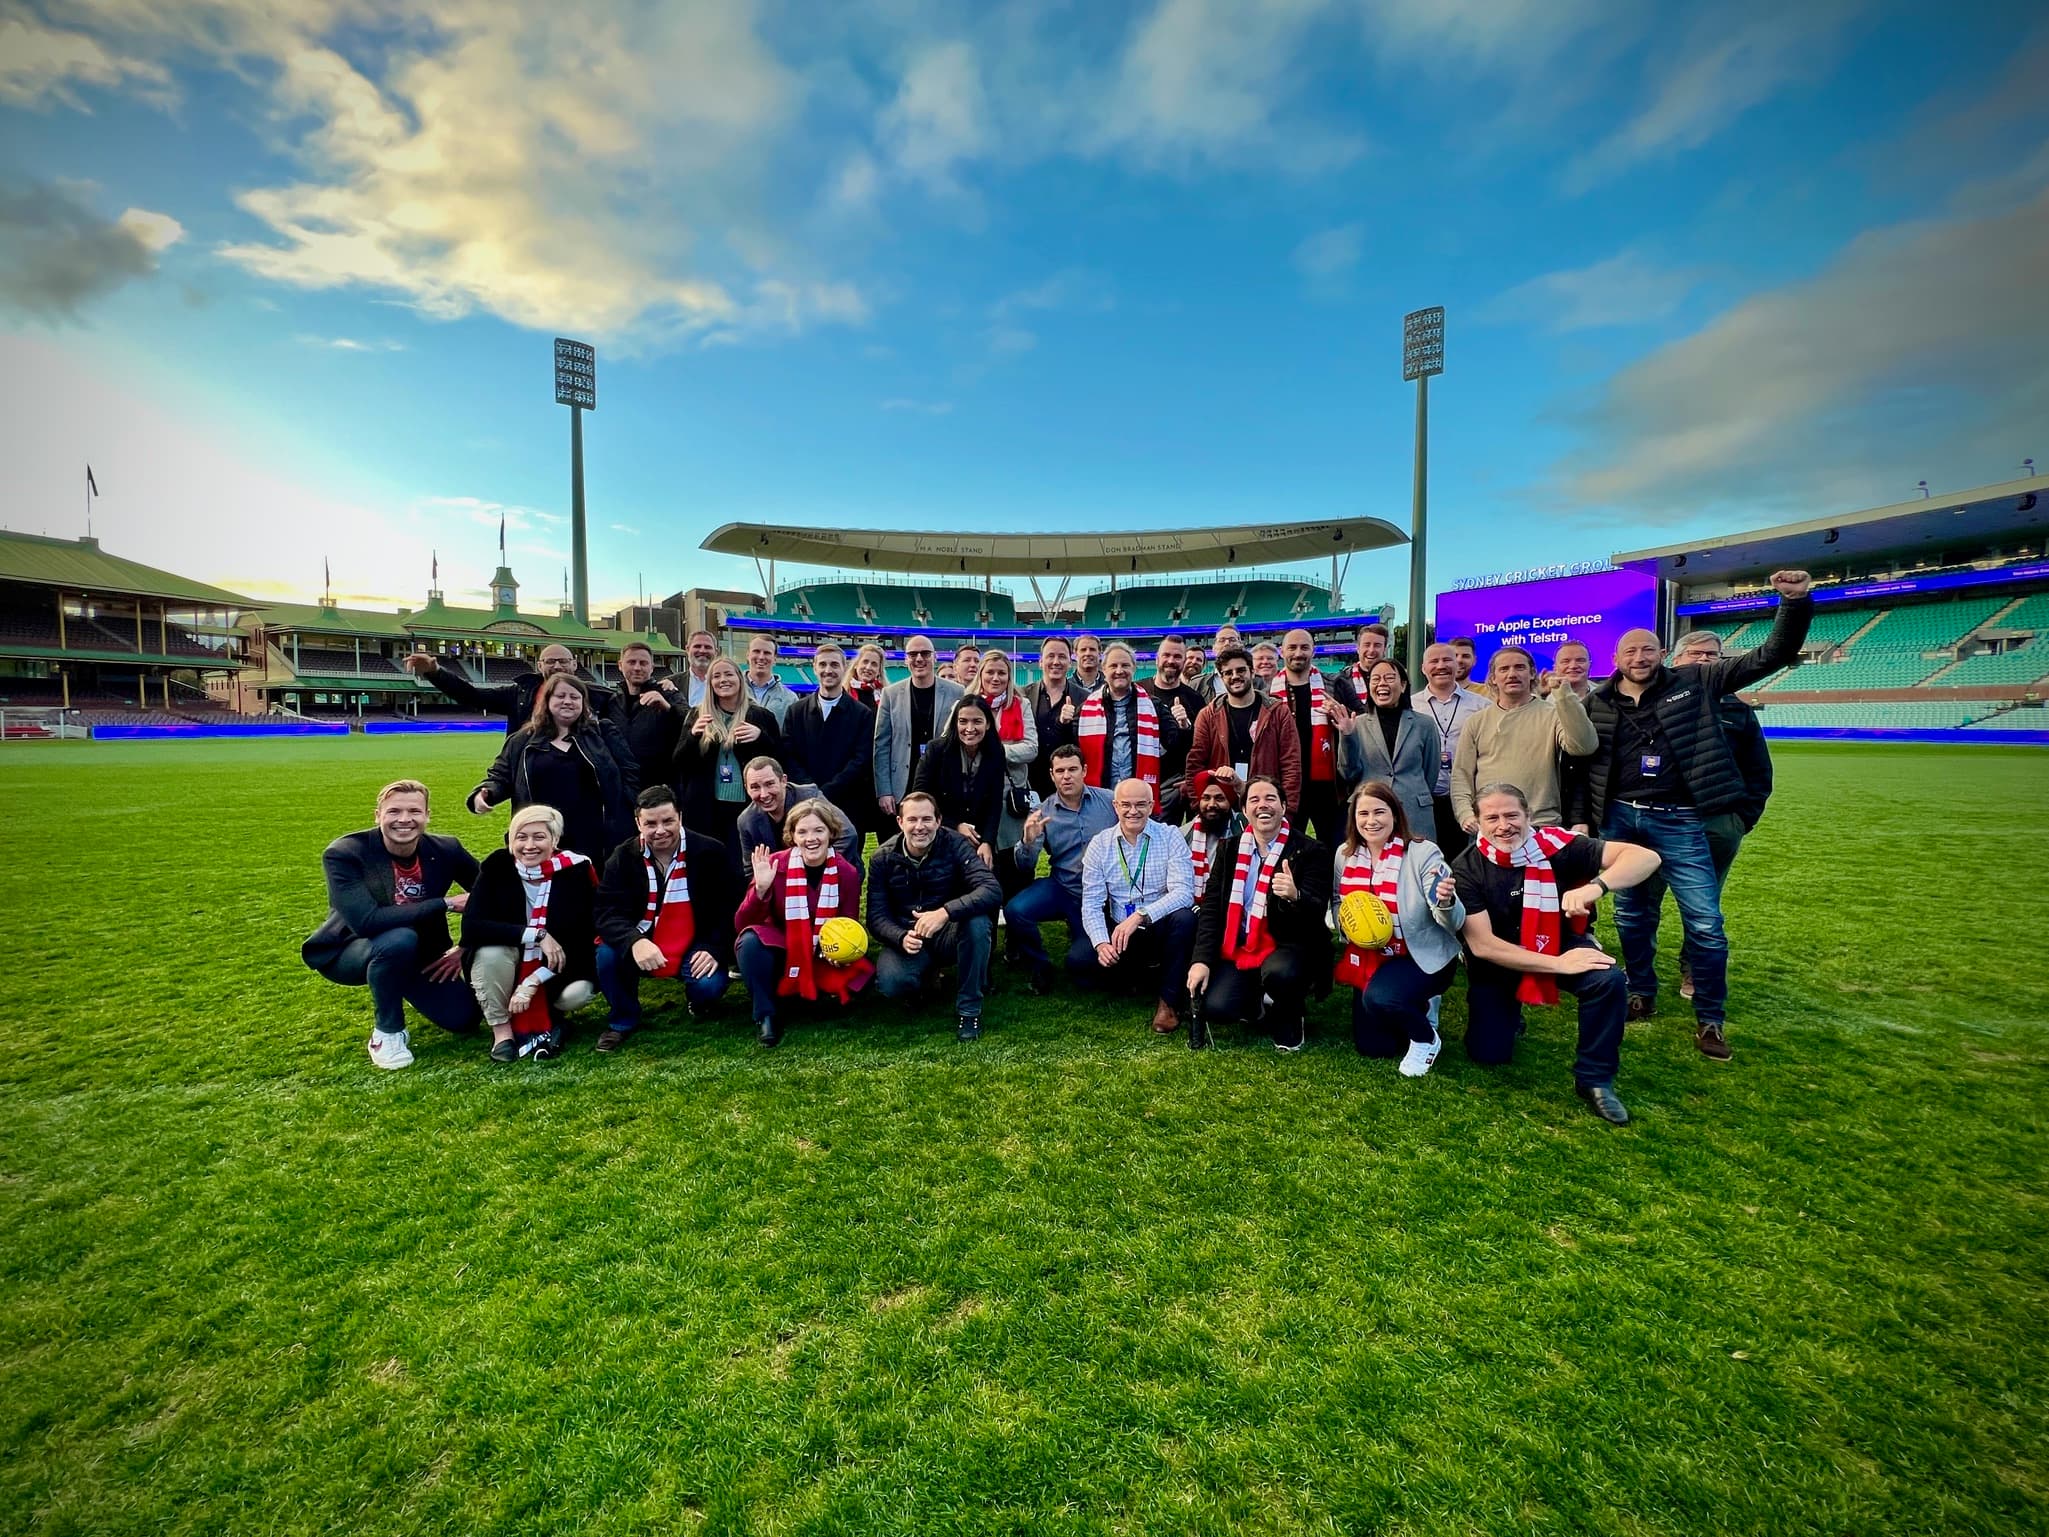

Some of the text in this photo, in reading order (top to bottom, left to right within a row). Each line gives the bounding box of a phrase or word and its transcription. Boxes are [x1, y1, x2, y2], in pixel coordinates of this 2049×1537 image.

[1452, 573, 1503, 590] SYDNEY
[1506, 564, 1566, 583] CRICKET
[1474, 614, 1602, 633] The Apple Experience
[1501, 632, 1568, 646] with Telstra
